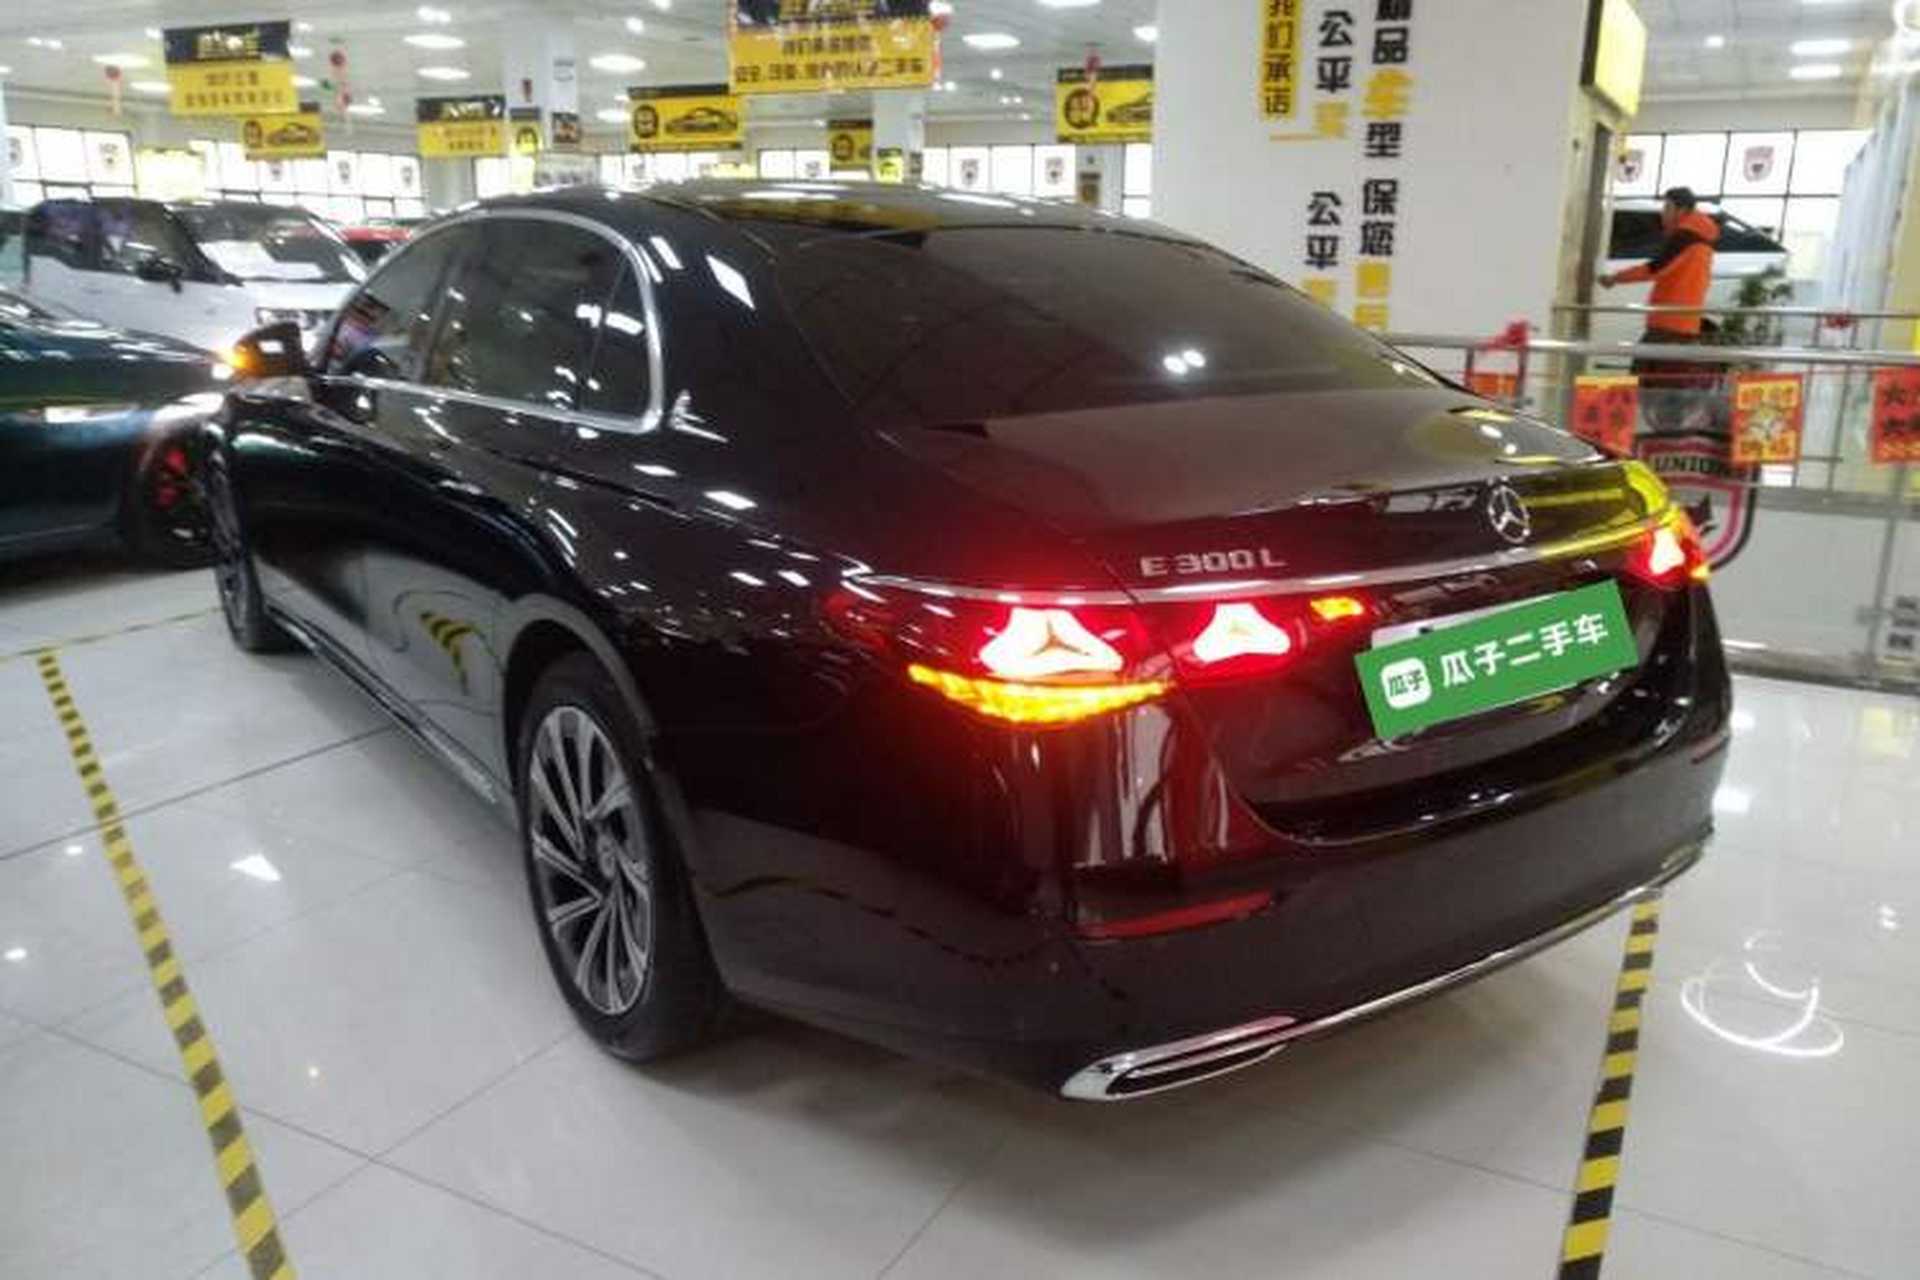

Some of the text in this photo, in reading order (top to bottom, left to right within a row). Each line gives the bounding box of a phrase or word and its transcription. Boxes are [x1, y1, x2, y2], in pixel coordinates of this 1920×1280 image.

[1140, 547, 1288, 577] E 300 L
